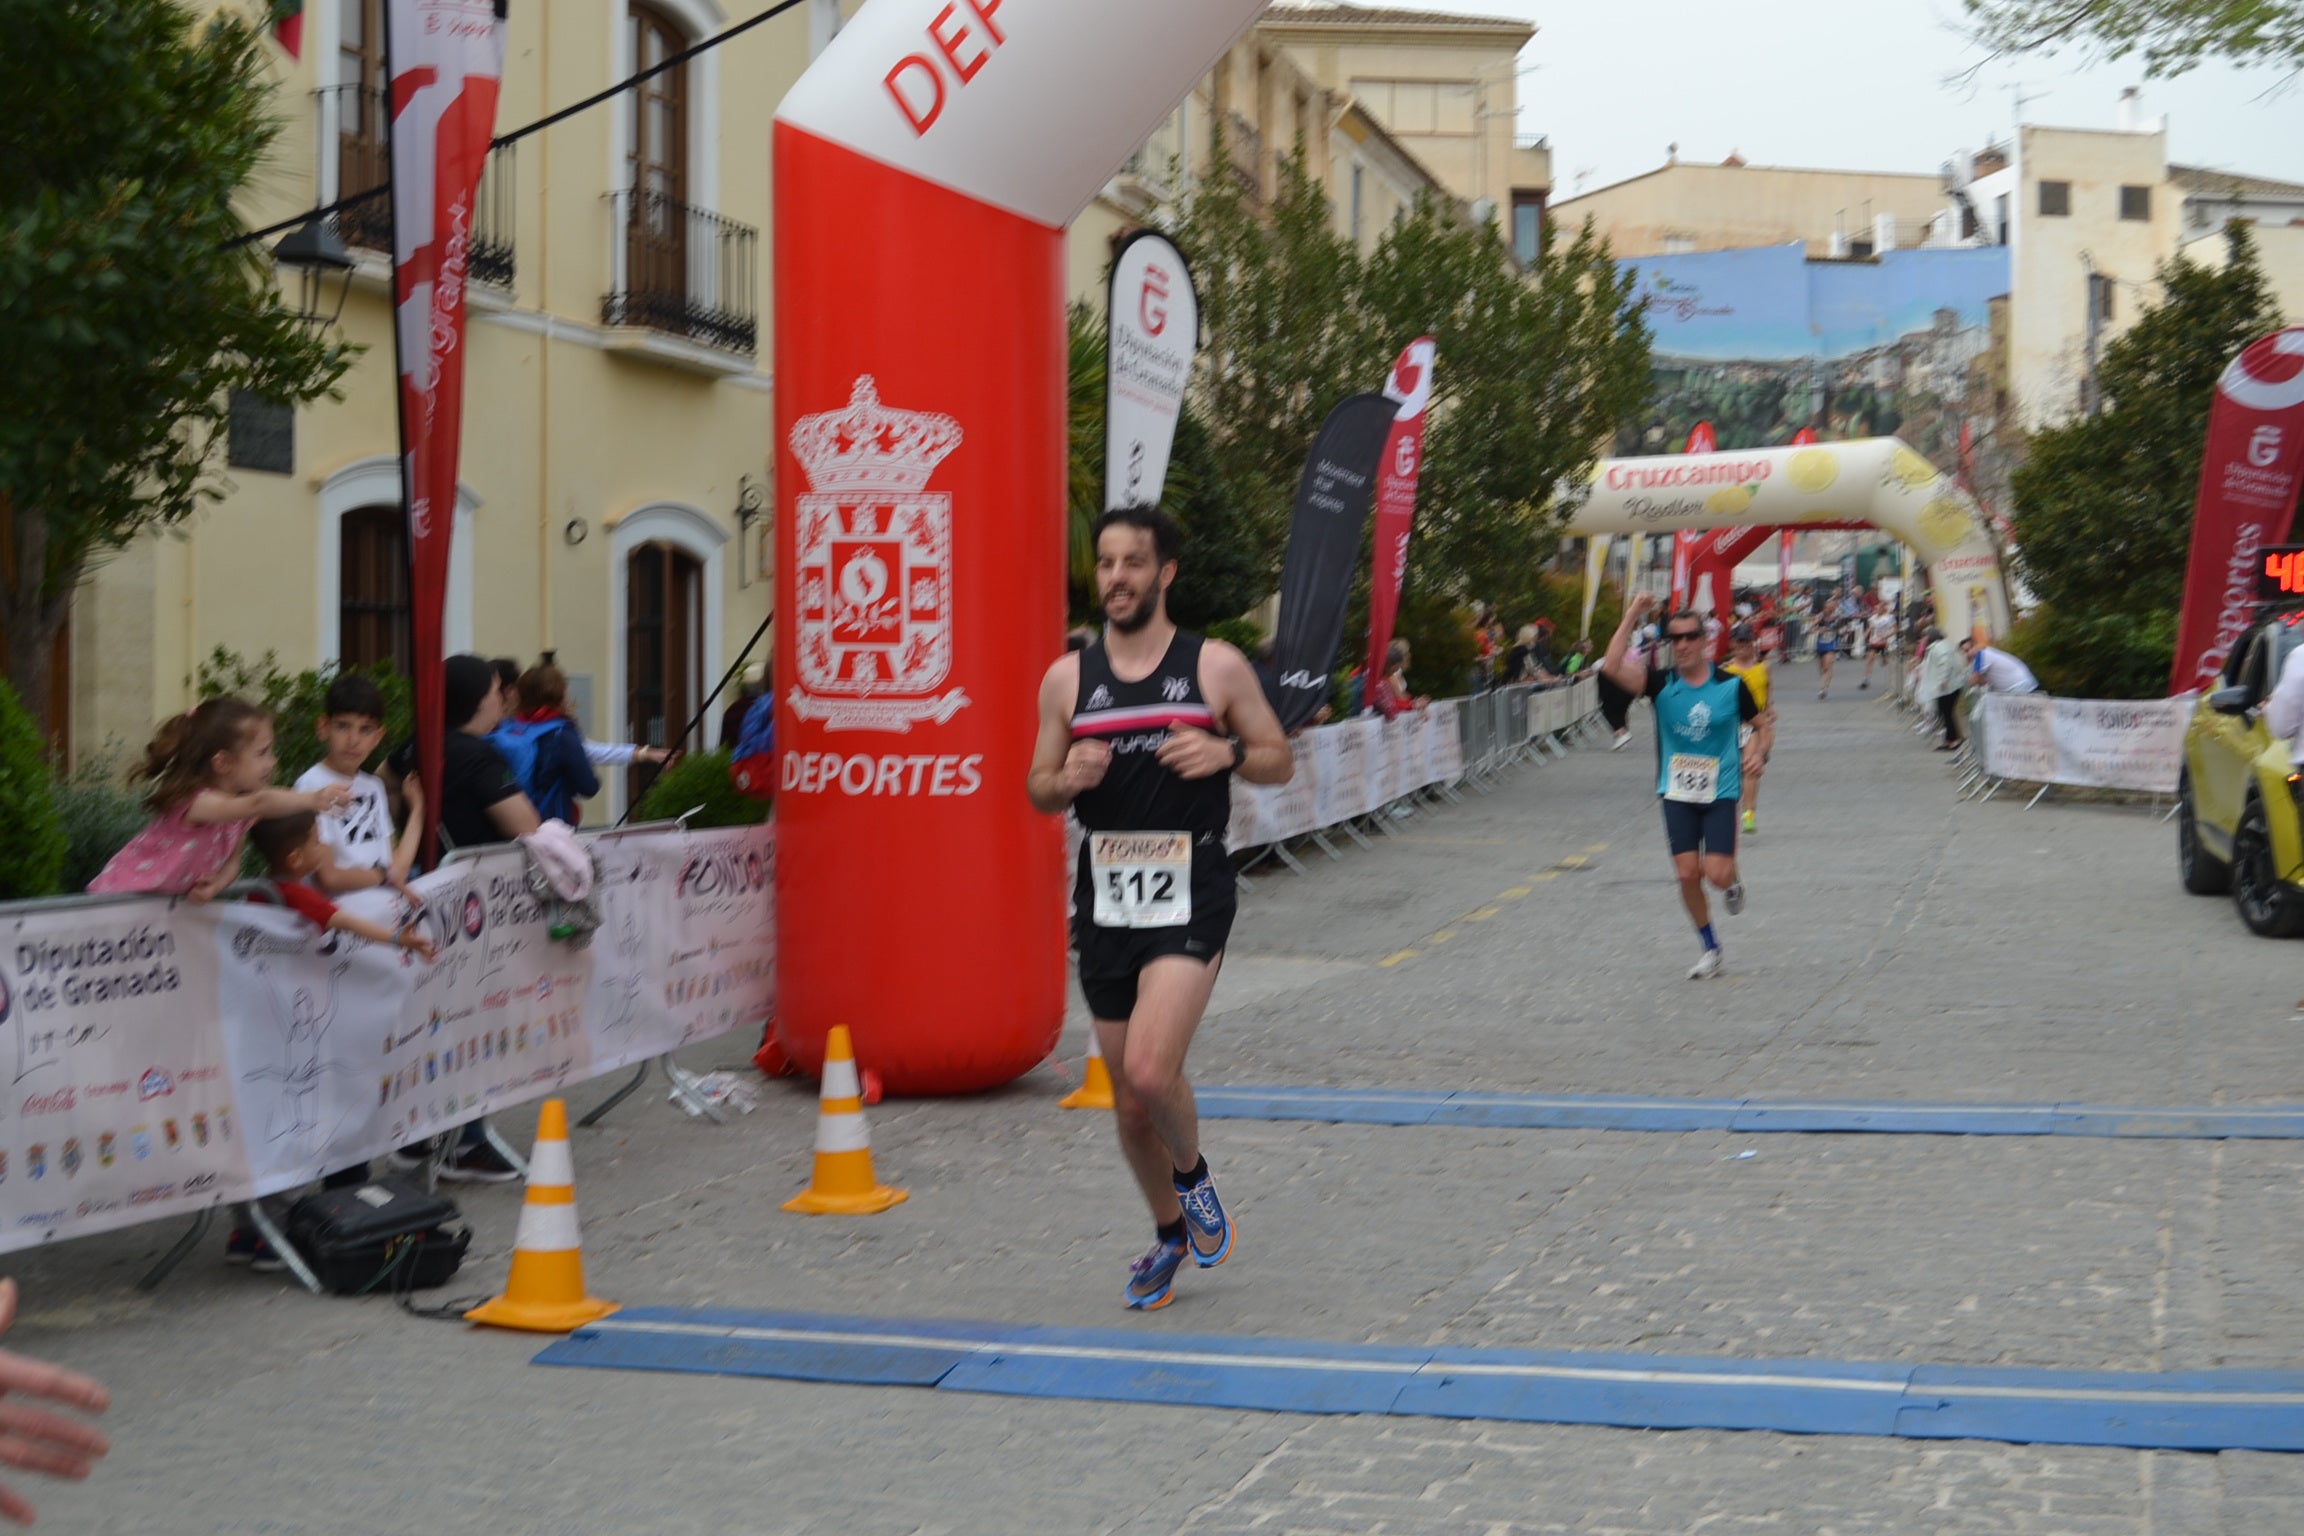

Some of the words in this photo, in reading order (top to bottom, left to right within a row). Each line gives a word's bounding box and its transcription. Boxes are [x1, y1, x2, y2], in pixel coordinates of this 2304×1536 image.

[1607, 459, 1773, 491] Cruzcampo
[781, 750, 985, 796] DEPORTES
[1108, 869, 1175, 904] 512
[16, 925, 176, 978] Diputación
[23, 981, 57, 1013] de
[61, 963, 181, 1007] Granada
